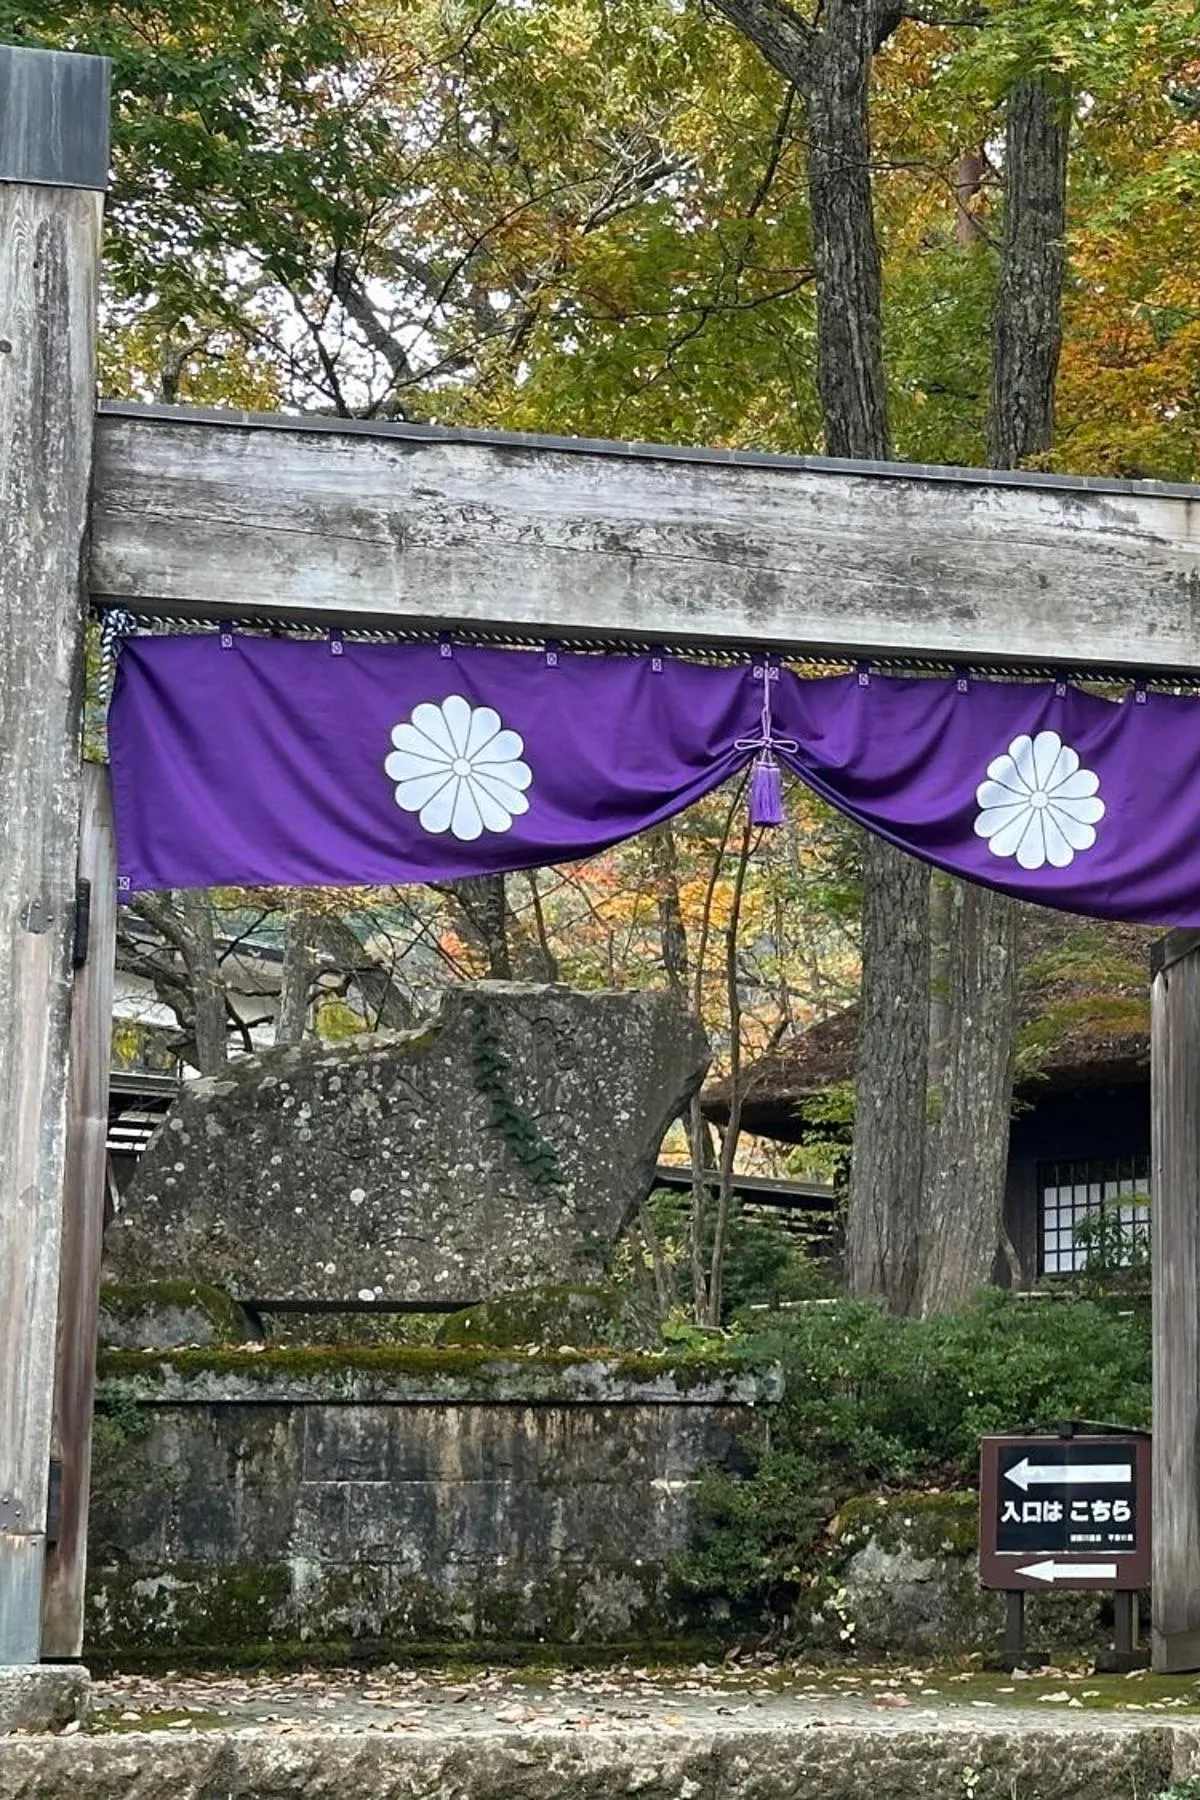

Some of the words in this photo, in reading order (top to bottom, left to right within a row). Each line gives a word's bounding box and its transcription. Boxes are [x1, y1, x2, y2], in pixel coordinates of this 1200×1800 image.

[1000, 1501, 1063, 1524] 入口は
[1070, 1500, 1132, 1523] こちら
